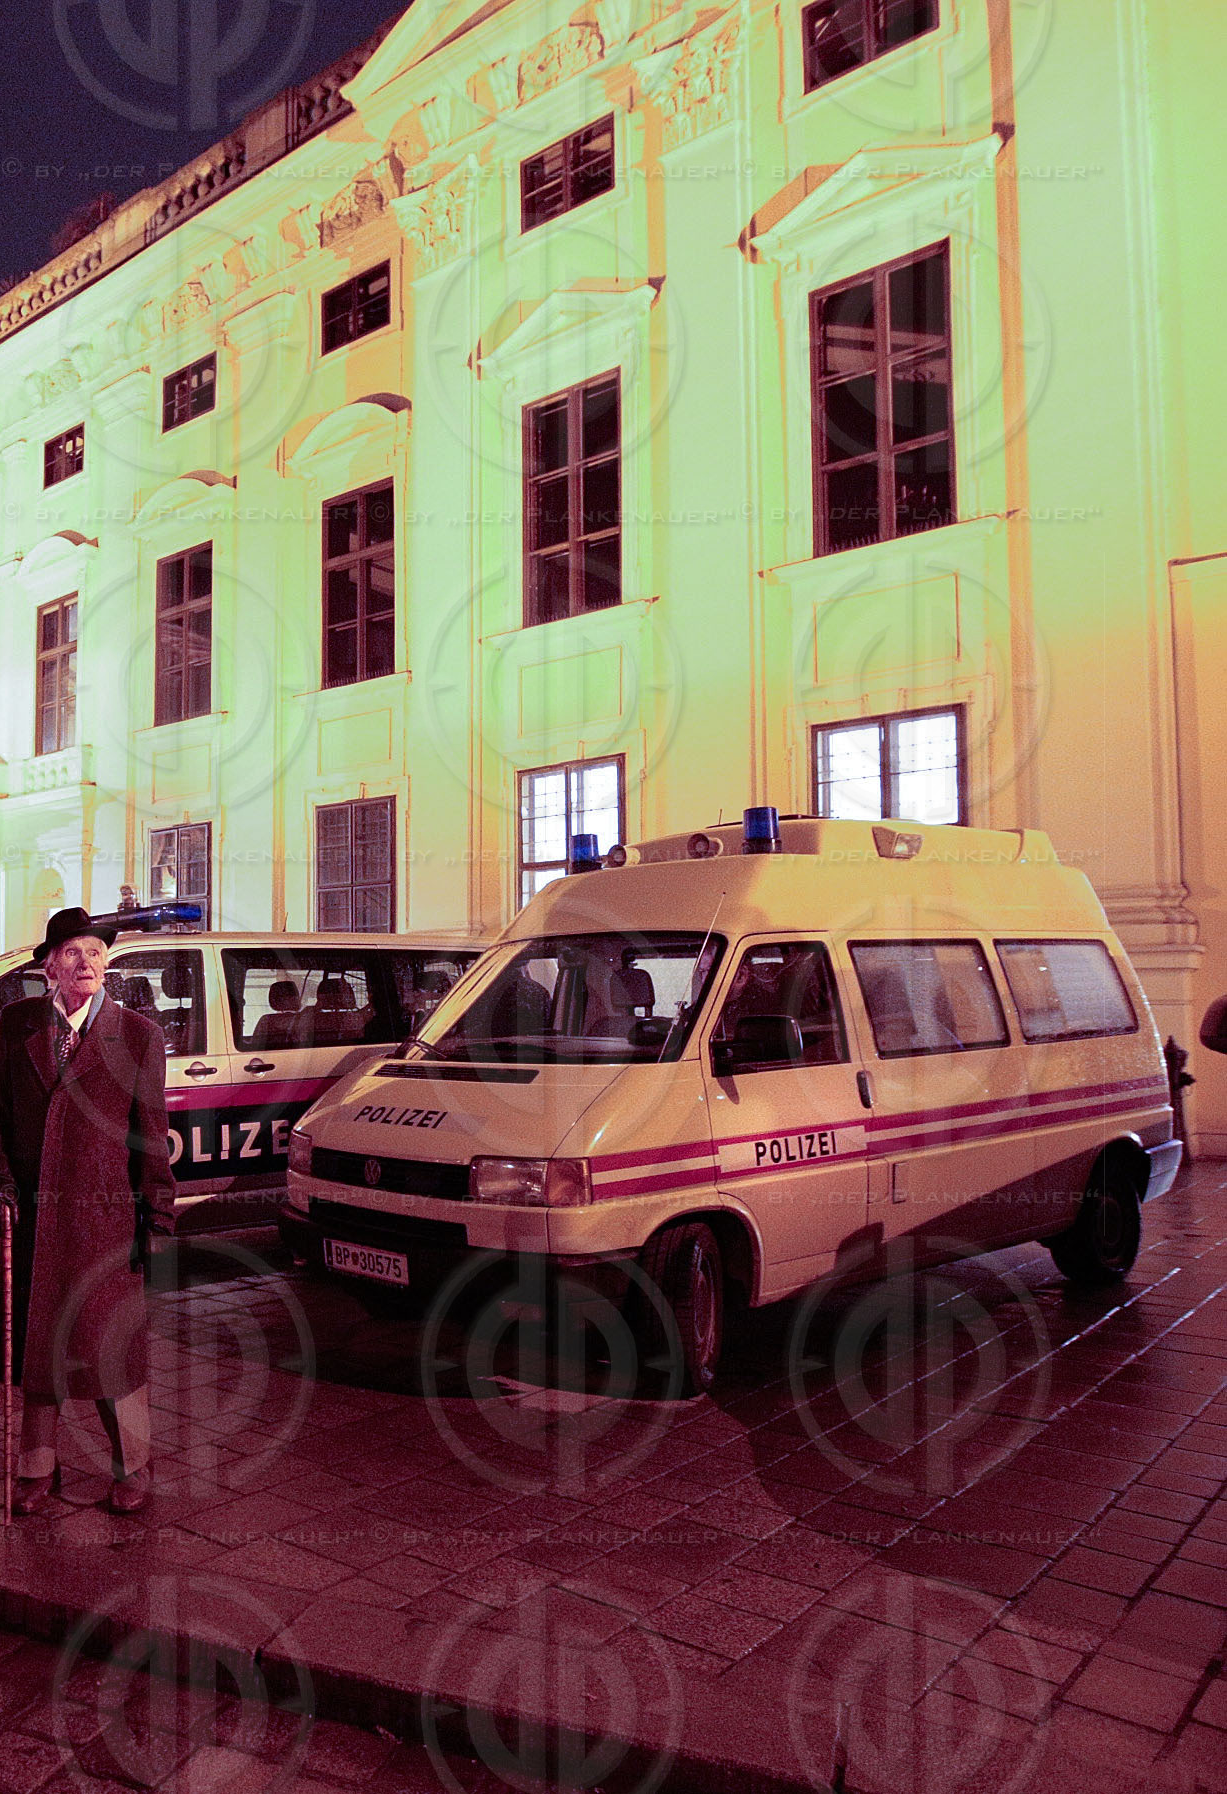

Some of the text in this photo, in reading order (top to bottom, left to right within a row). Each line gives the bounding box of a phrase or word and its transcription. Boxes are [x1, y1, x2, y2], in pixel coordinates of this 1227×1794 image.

[353, 1105, 448, 1129] POLIZEI
[754, 1131, 837, 1166] POLIZEI
[335, 1245, 402, 1278] BP 30575
